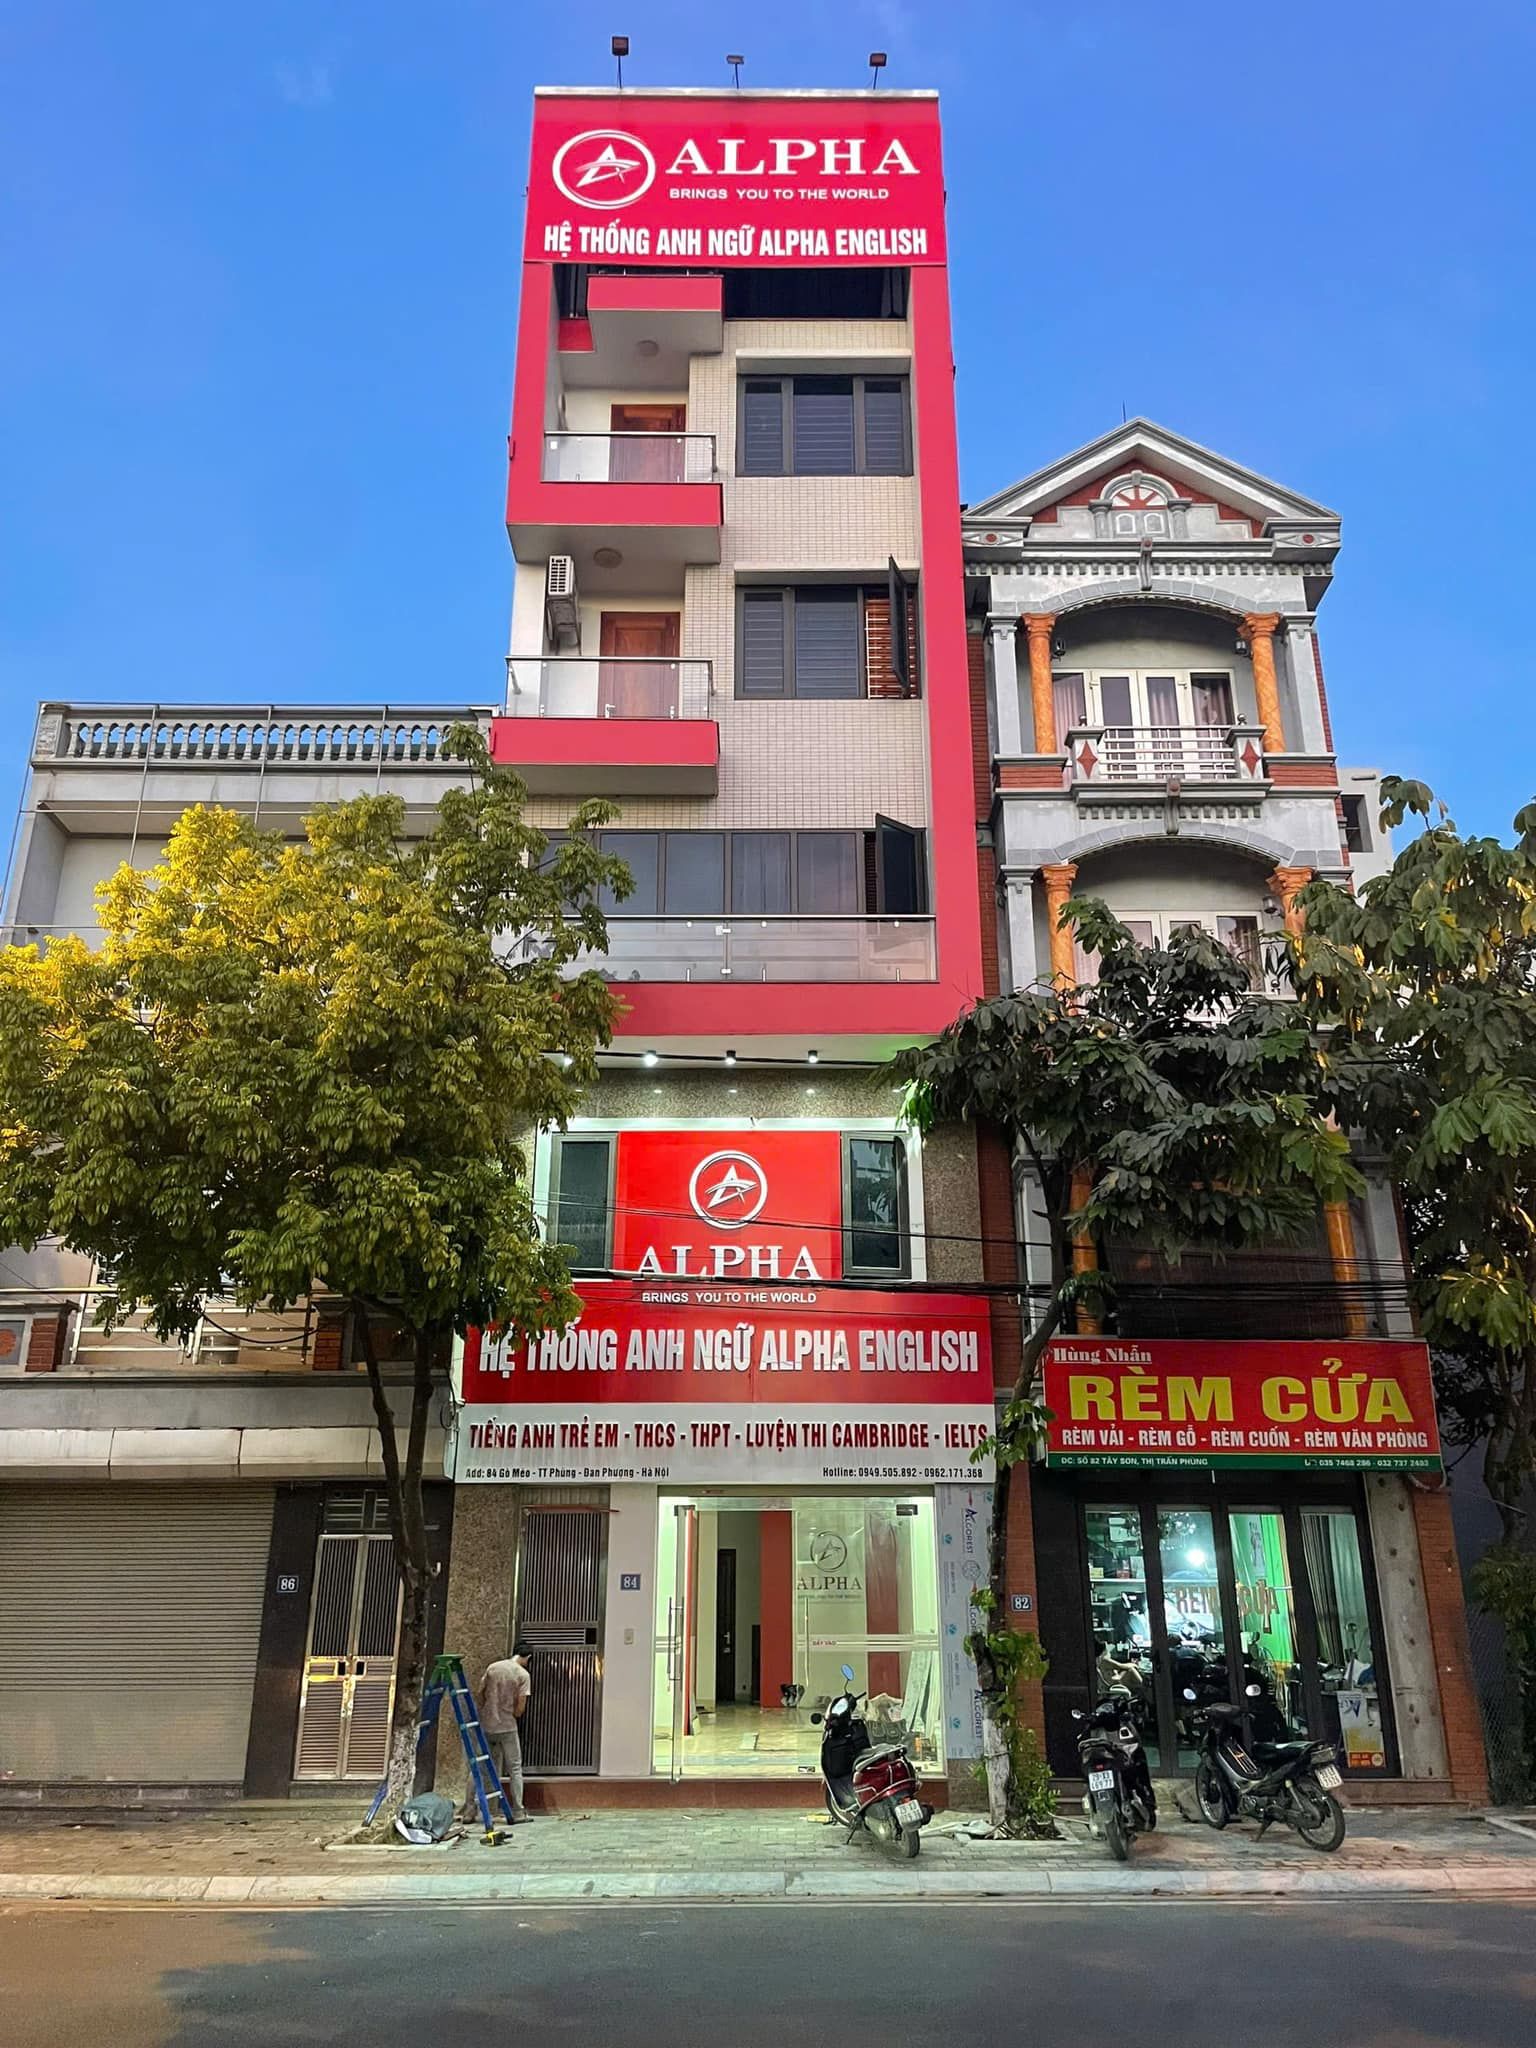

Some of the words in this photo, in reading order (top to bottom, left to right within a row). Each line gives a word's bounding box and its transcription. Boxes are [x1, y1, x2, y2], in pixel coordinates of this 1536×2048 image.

[665, 138, 921, 176] ALPHA
[669, 188, 728, 200] BRINGS
[736, 188, 768, 200] YOU
[773, 188, 792, 200] TO
[797, 188, 828, 200] THE
[832, 188, 889, 200] WORLD
[543, 220, 572, 258] HỆ
[578, 218, 650, 256] THỐNG
[656, 228, 702, 256] ANH
[708, 224, 755, 256] NGỮ
[759, 229, 830, 257] ALPHA
[834, 228, 928, 256] ENGLISH
[638, 1245, 823, 1280] ALPHA
[642, 1292, 689, 1303] BRINGS
[695, 1292, 721, 1303] YOU
[725, 1292, 739, 1303] TO
[743, 1292, 767, 1303] THE
[770, 1292, 817, 1304] WORLD
[525, 1316, 618, 1372] THỐNG
[625, 1329, 685, 1372] ANH
[693, 1321, 755, 1372] NGỮ
[759, 1329, 851, 1372] ALPHA
[859, 1329, 979, 1373] ENGLISH
[1053, 1346, 1101, 1364] Hùng
[1068, 1365, 1235, 1422] RÈM
[1260, 1357, 1415, 1424] CỬA
[470, 1416, 517, 1449] TIẾNG
[521, 1424, 555, 1449] ANH
[560, 1415, 589, 1449] TRẺ
[594, 1423, 619, 1449] EM
[634, 1423, 676, 1449] THCS
[691, 1423, 731, 1449] THPT
[746, 1418, 797, 1453] LUYỆN
[801, 1423, 827, 1449] THI
[832, 1423, 929, 1449] CAMBRIDGE
[945, 1424, 988, 1449] IELTS
[1062, 1426, 1096, 1446] RÈM
[1100, 1424, 1124, 1446] VẢI
[1138, 1427, 1172, 1447] RÈM
[1176, 1424, 1197, 1447] GỖ
[1211, 1427, 1245, 1447] RÈM
[1248, 1425, 1290, 1447] CUỐN
[1304, 1428, 1338, 1448] RÈM
[1341, 1428, 1373, 1448] VĂN
[1376, 1428, 1429, 1449] PHÒNG
[465, 1468, 485, 1479] Add:
[487, 1468, 497, 1478] 84
[538, 1468, 547, 1478] TT
[823, 1467, 857, 1478] Hotline:
[859, 1467, 917, 1478] 0949.505.892
[965, 1508, 978, 1554] ALCOREST
[280, 1578, 296, 1590] 86
[623, 1575, 638, 1589] 84
[797, 1576, 862, 1590] ALPHA
[1014, 1596, 1030, 1610] 82
